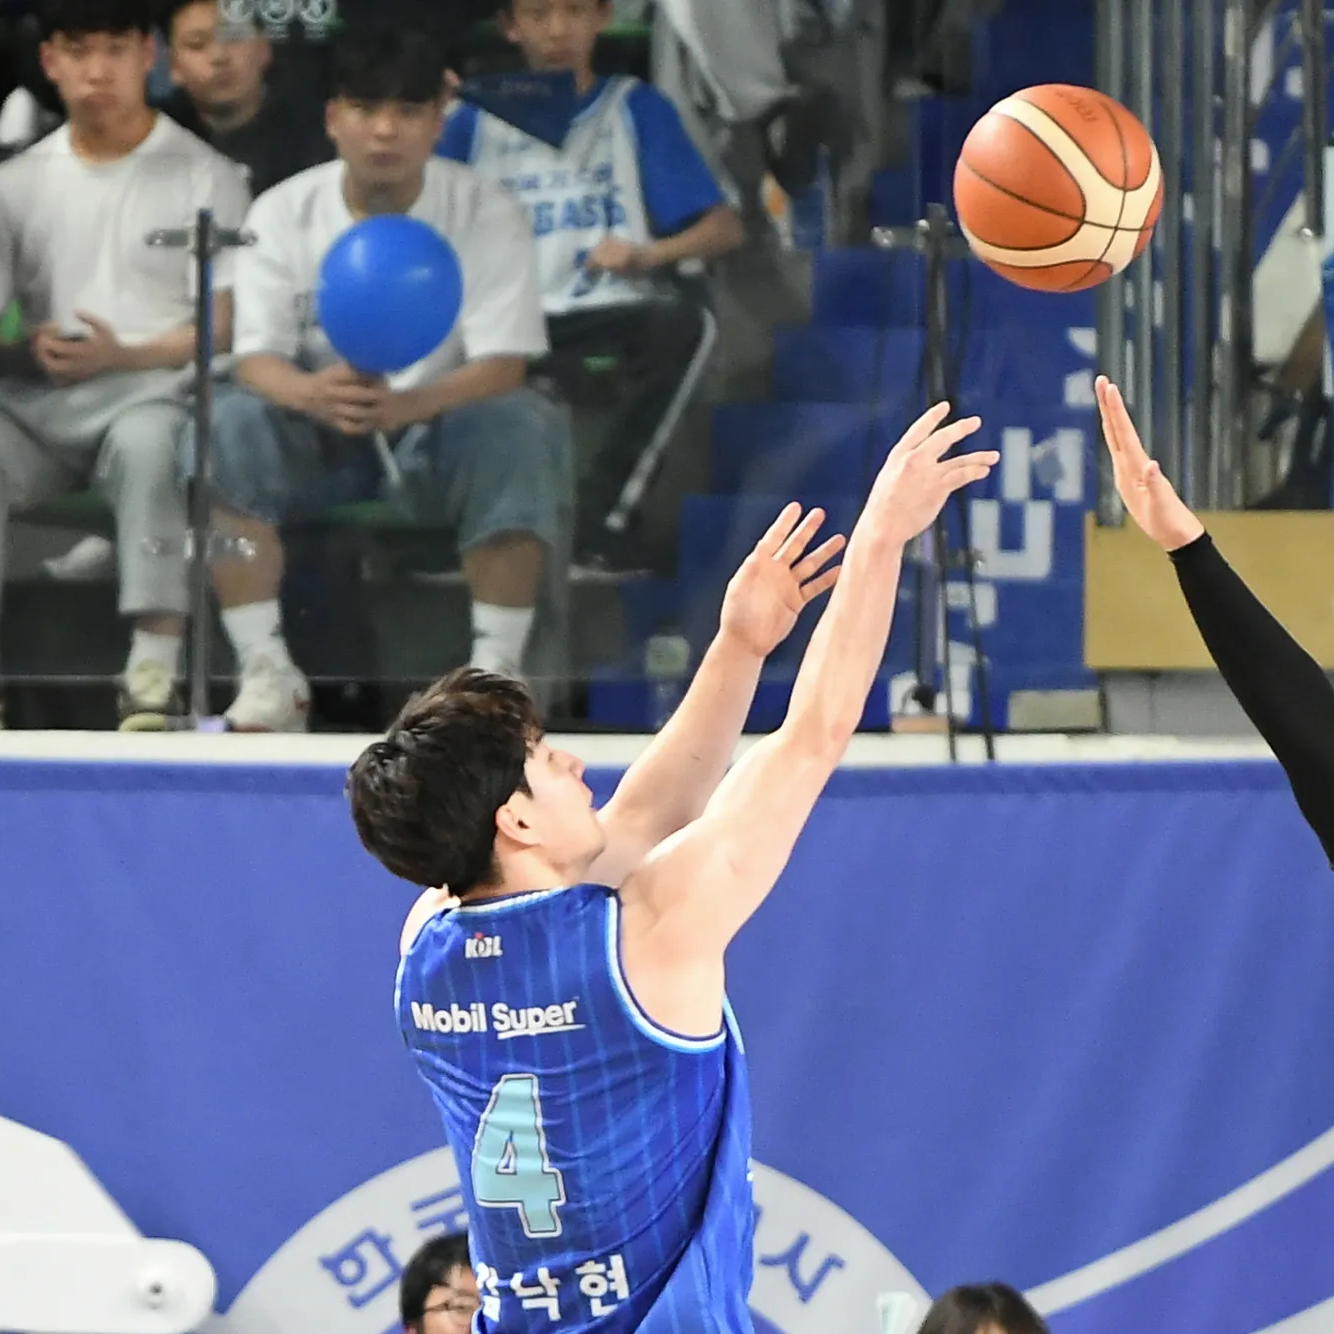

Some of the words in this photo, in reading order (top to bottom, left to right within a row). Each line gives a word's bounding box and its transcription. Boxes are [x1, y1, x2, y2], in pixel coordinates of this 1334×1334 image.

[411, 1001, 487, 1033] Mobil
[492, 1000, 585, 1039] Super
[471, 1073, 566, 1239] 4
